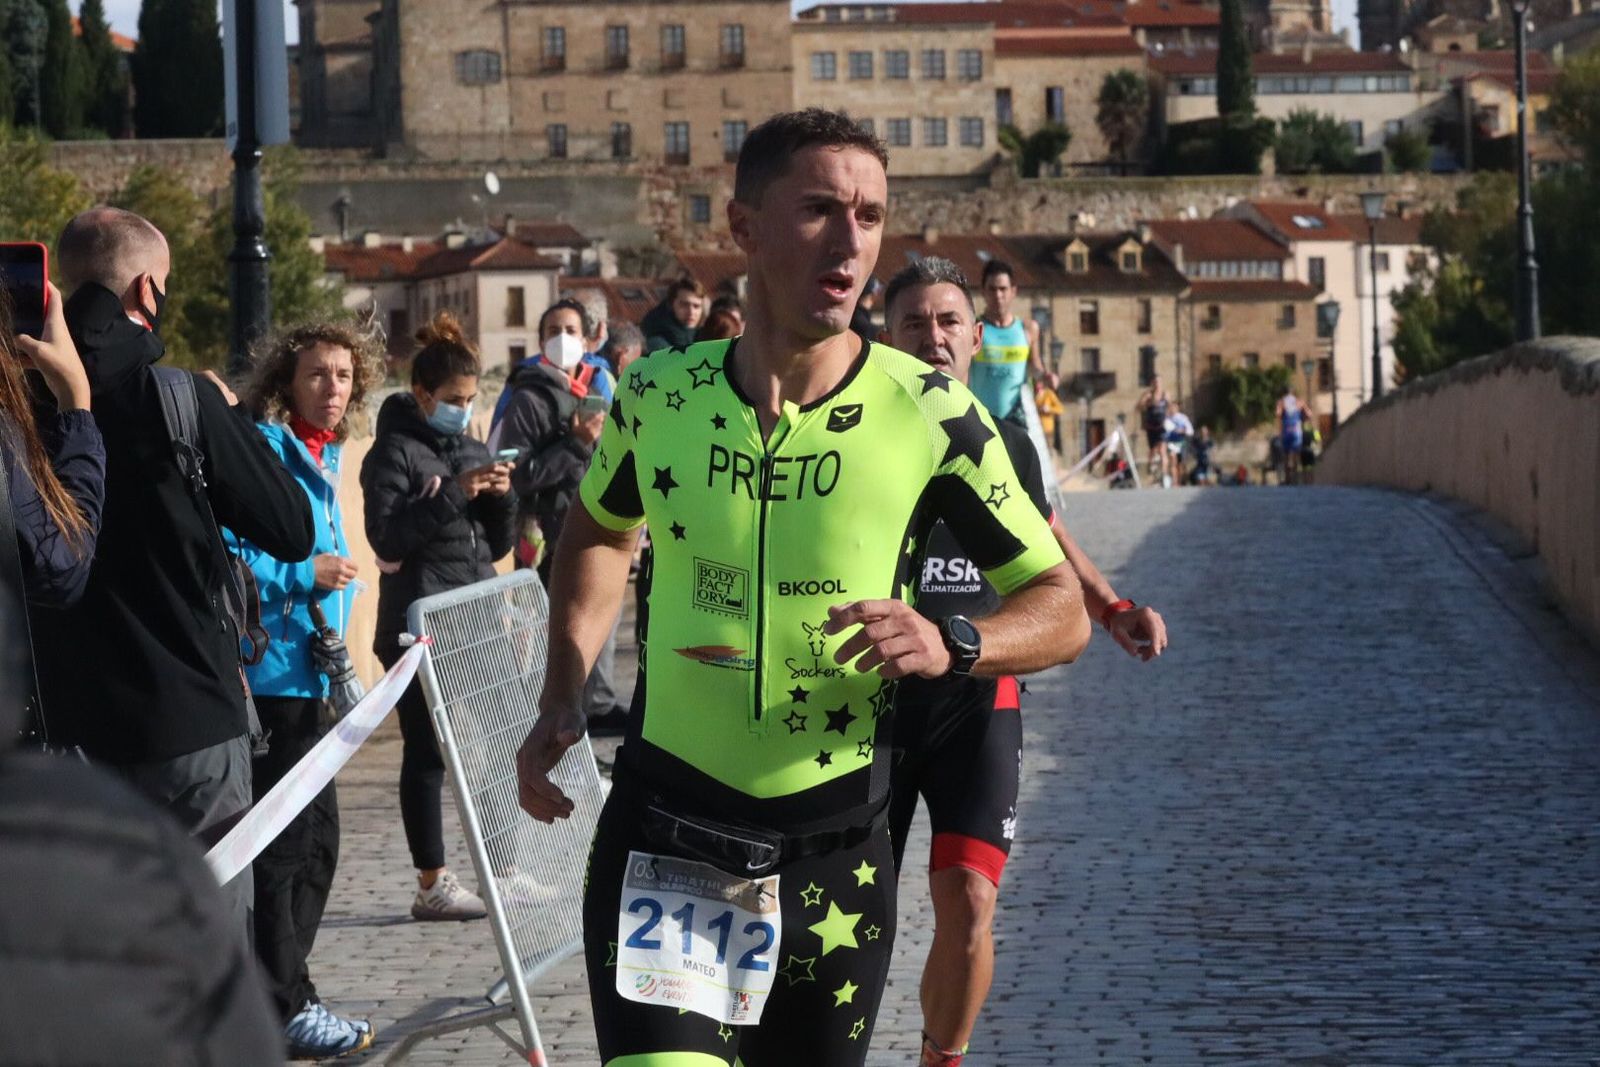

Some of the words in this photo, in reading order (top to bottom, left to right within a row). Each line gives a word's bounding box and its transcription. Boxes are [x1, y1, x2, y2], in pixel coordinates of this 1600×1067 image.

[707, 443, 841, 501] PRIETO
[700, 565, 738, 584] BODY
[699, 577, 735, 594] FACT
[778, 579, 847, 596] BKOOL
[698, 589, 729, 605] ORY
[785, 658, 847, 680] Sockers
[625, 897, 776, 972] 2112
[682, 958, 716, 978] MATEO
